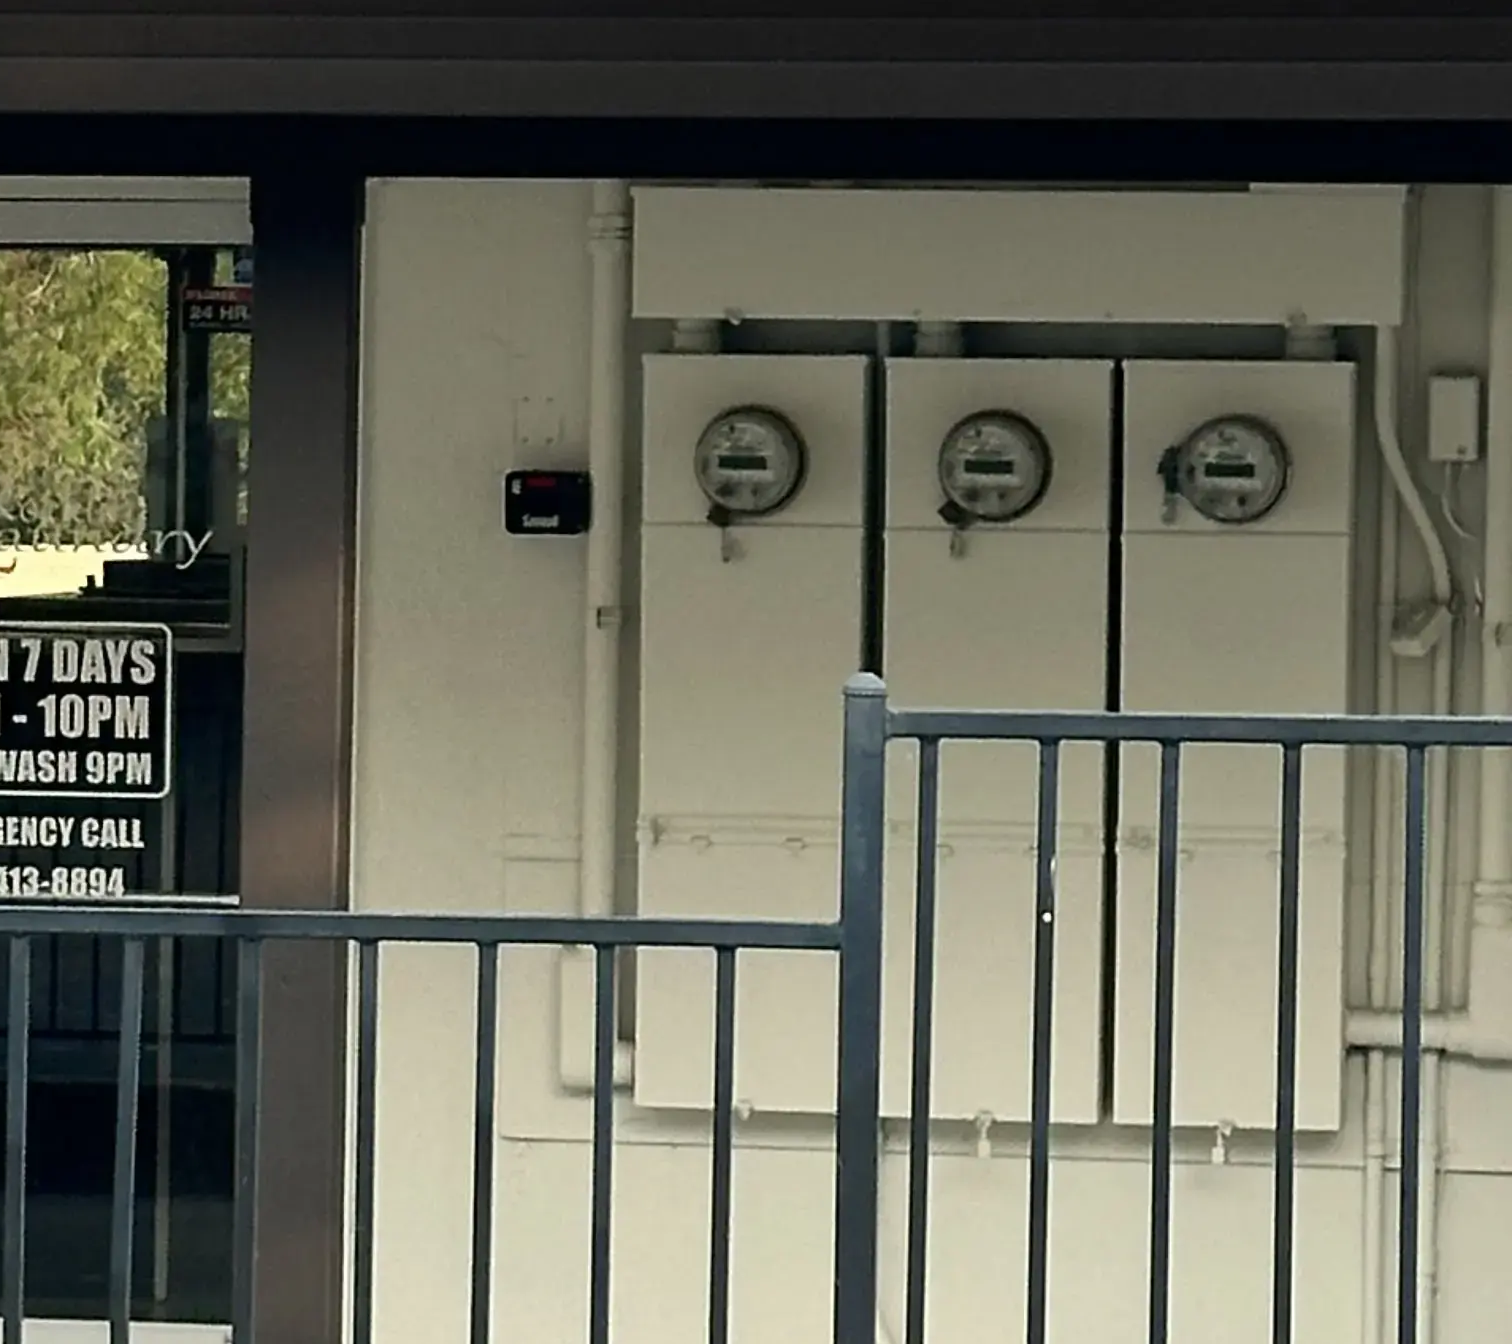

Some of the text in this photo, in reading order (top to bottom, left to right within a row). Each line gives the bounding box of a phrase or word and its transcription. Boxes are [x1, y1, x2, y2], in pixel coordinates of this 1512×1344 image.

[20, 638, 42, 683] 7
[52, 638, 156, 684] DAYS
[12, 714, 28, 724] -
[37, 693, 150, 739] 10PM
[85, 750, 152, 785] 9PM
[81, 817, 145, 849] CALL
